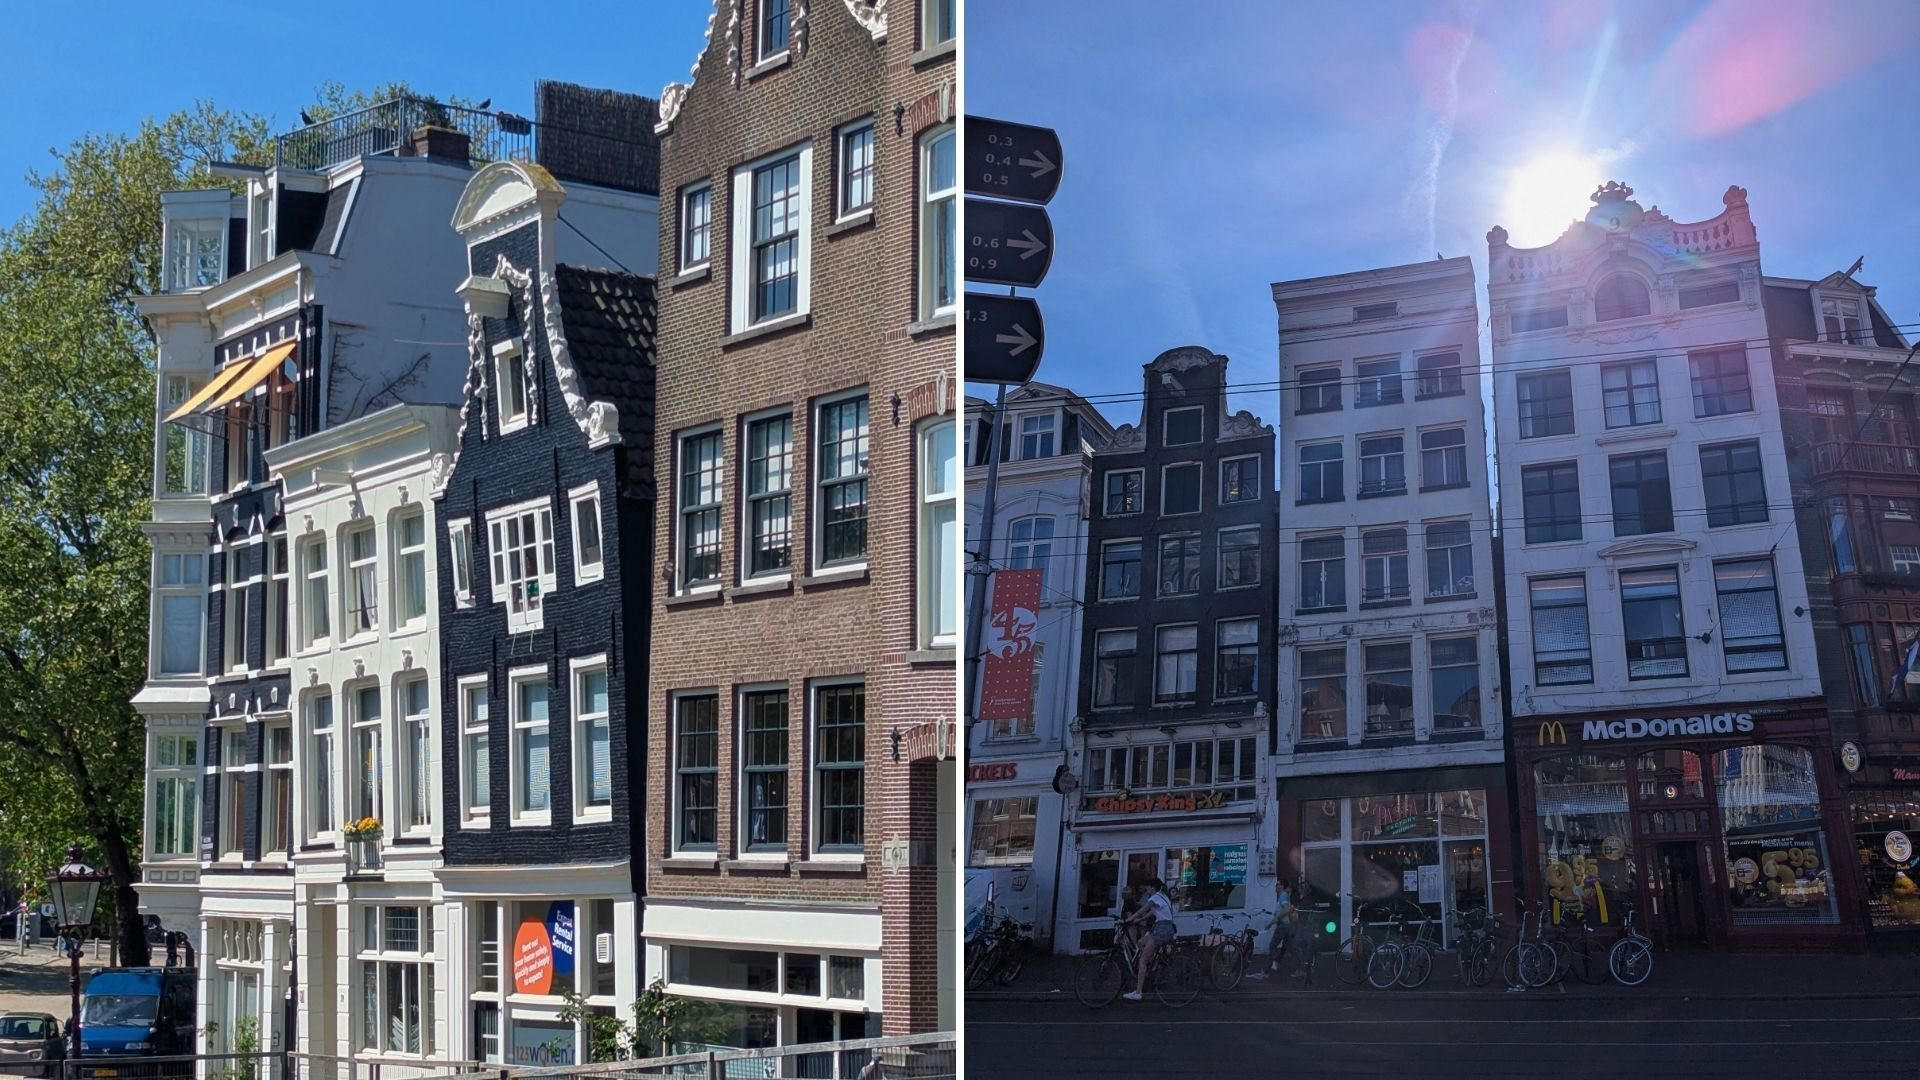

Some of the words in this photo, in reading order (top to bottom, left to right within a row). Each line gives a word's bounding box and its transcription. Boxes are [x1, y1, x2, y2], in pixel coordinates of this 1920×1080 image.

[1582, 712, 1754, 741] McDonald's
[1665, 786, 1675, 797] 9
[554, 922, 573, 942] Rental
[552, 934, 573, 956] Service
